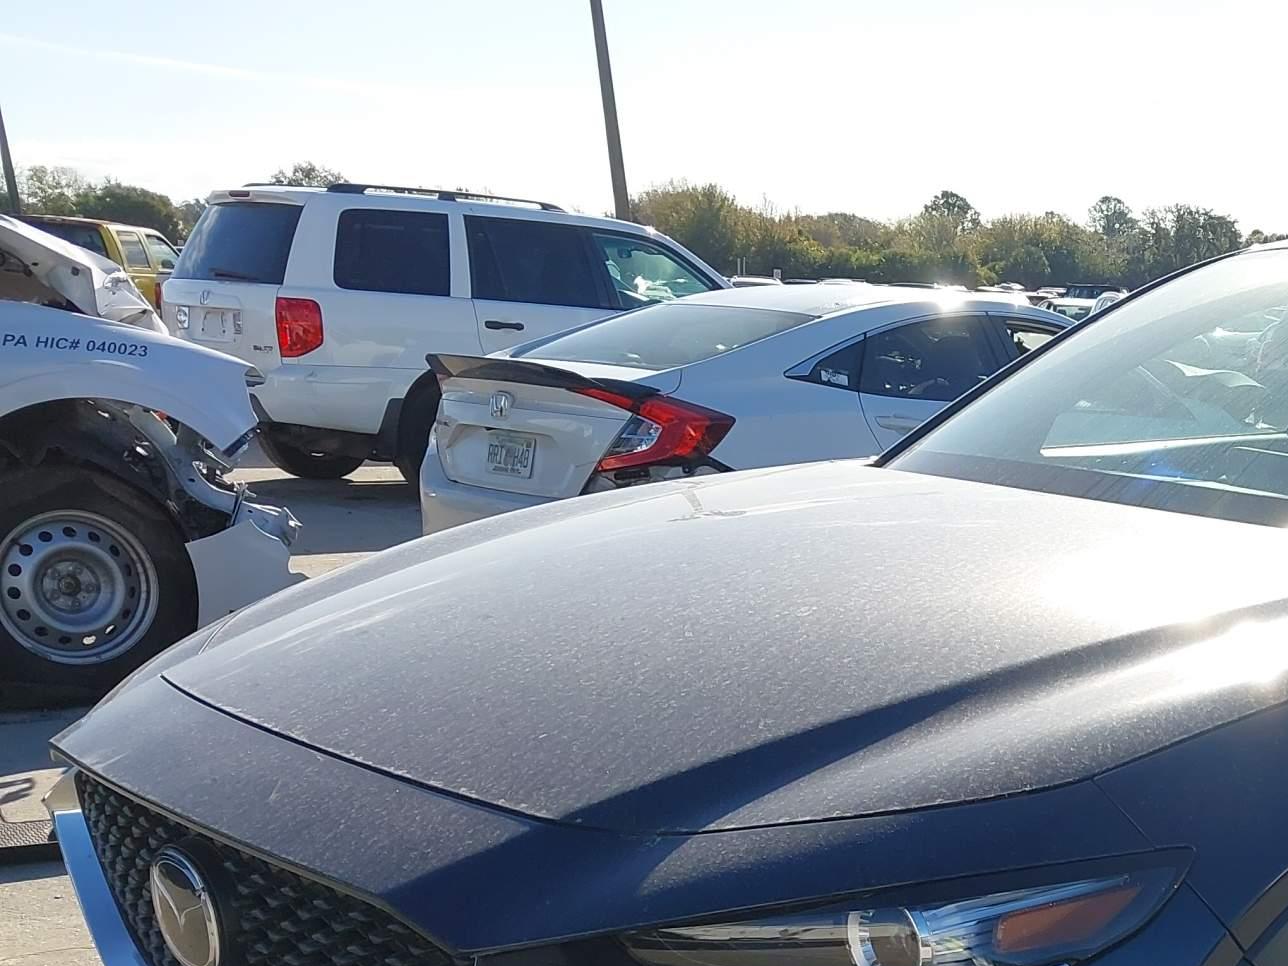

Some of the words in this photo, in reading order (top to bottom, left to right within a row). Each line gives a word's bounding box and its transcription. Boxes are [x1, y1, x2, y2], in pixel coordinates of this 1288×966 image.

[2, 333, 28, 347] PA
[36, 336, 81, 351] HIC#
[86, 340, 149, 357] 040023
